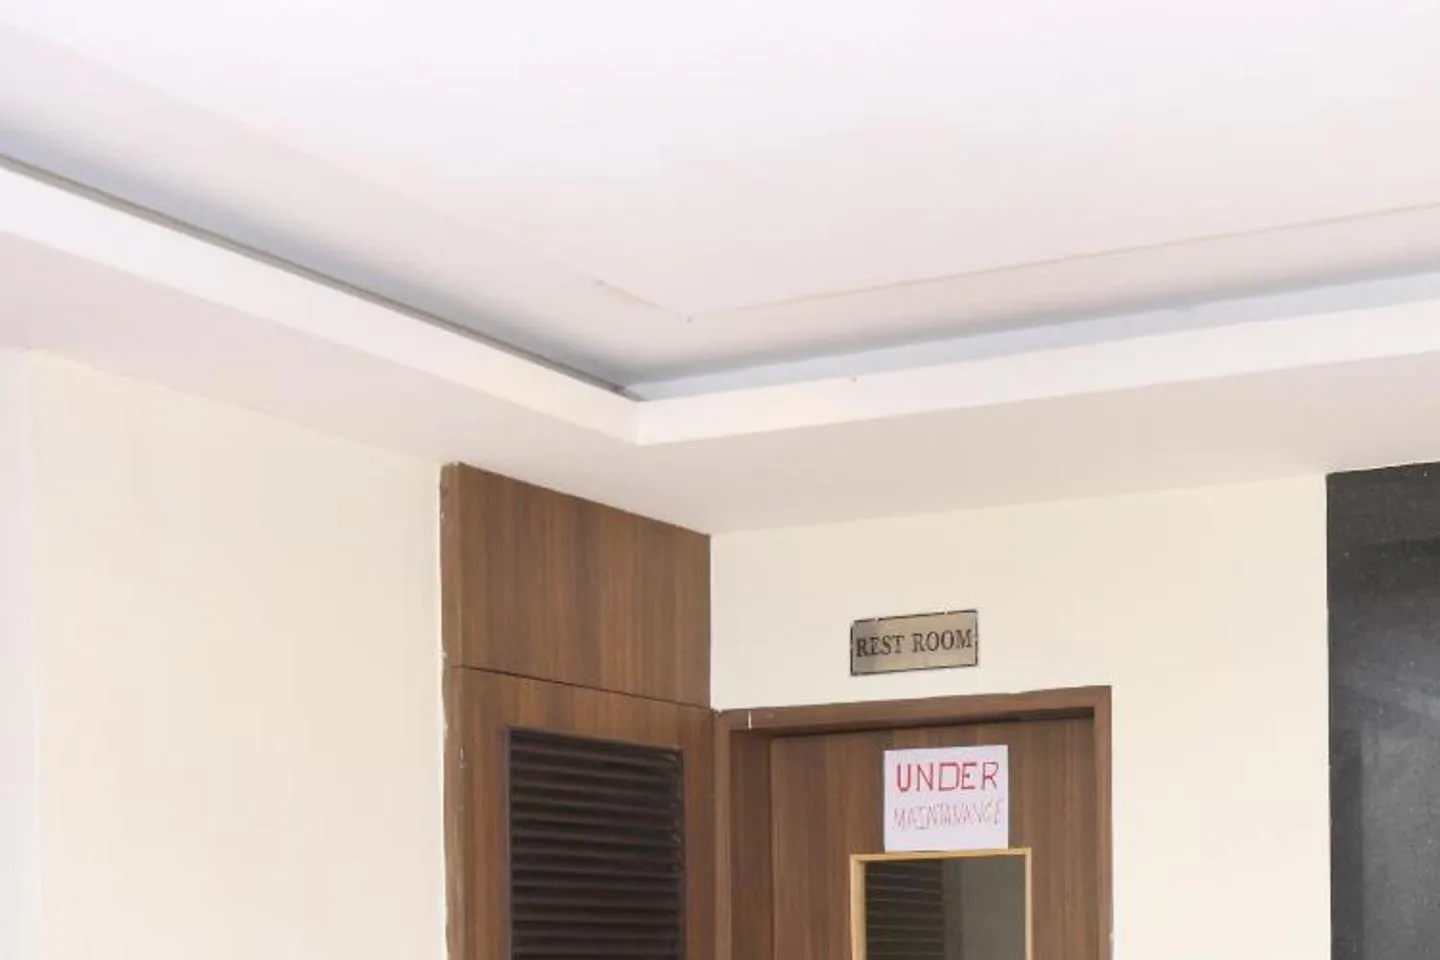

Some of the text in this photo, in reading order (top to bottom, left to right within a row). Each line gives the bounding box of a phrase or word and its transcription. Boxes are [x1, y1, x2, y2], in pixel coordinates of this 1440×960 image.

[856, 629, 972, 657] REST ROOM
[896, 762, 1000, 793] UNDER
